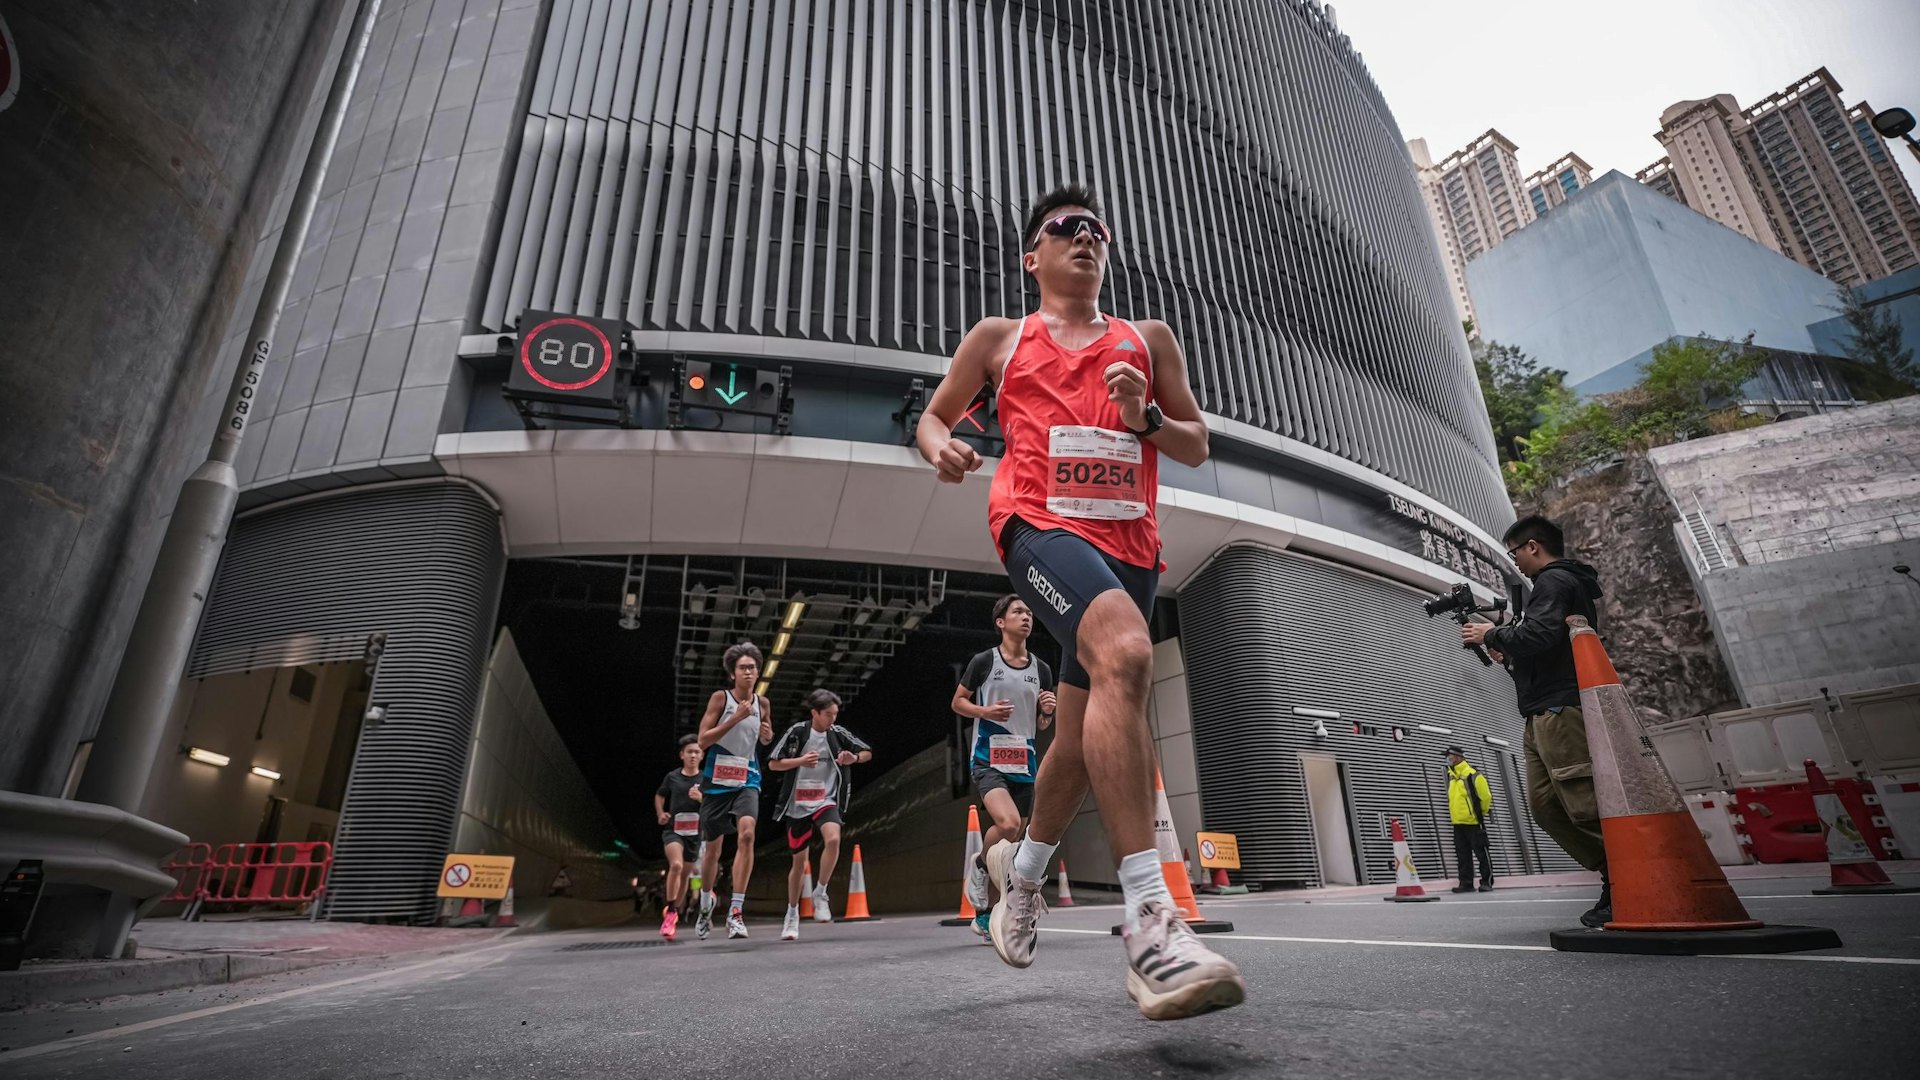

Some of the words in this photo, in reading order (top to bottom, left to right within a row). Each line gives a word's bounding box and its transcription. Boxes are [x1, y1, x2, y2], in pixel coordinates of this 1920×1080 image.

[539, 338, 595, 369] 80
[231, 340, 269, 430] GF5086
[1055, 462, 1136, 488] 50254
[1388, 494, 1428, 525] TSEUNG
[1027, 565, 1072, 615] ADIZERO
